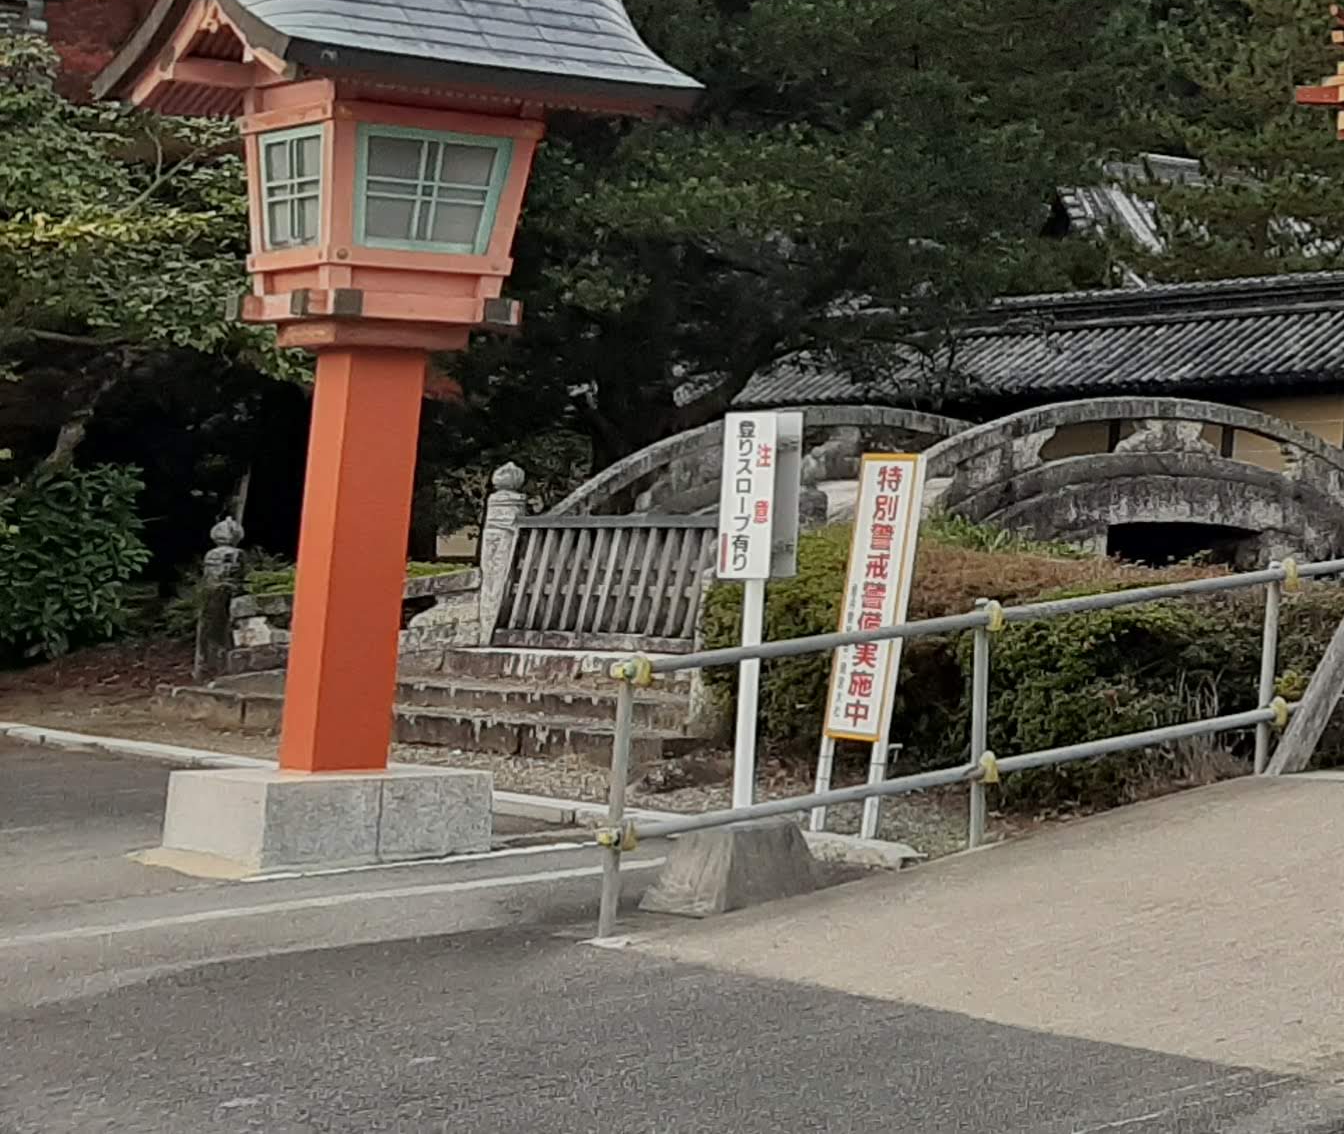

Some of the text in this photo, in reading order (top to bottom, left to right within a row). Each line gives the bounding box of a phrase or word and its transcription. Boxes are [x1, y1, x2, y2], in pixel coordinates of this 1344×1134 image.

[731, 420, 756, 572] 登りスロープ有り
[753, 443, 772, 525] 注意
[844, 465, 903, 728] 特別警戒警備実施中
